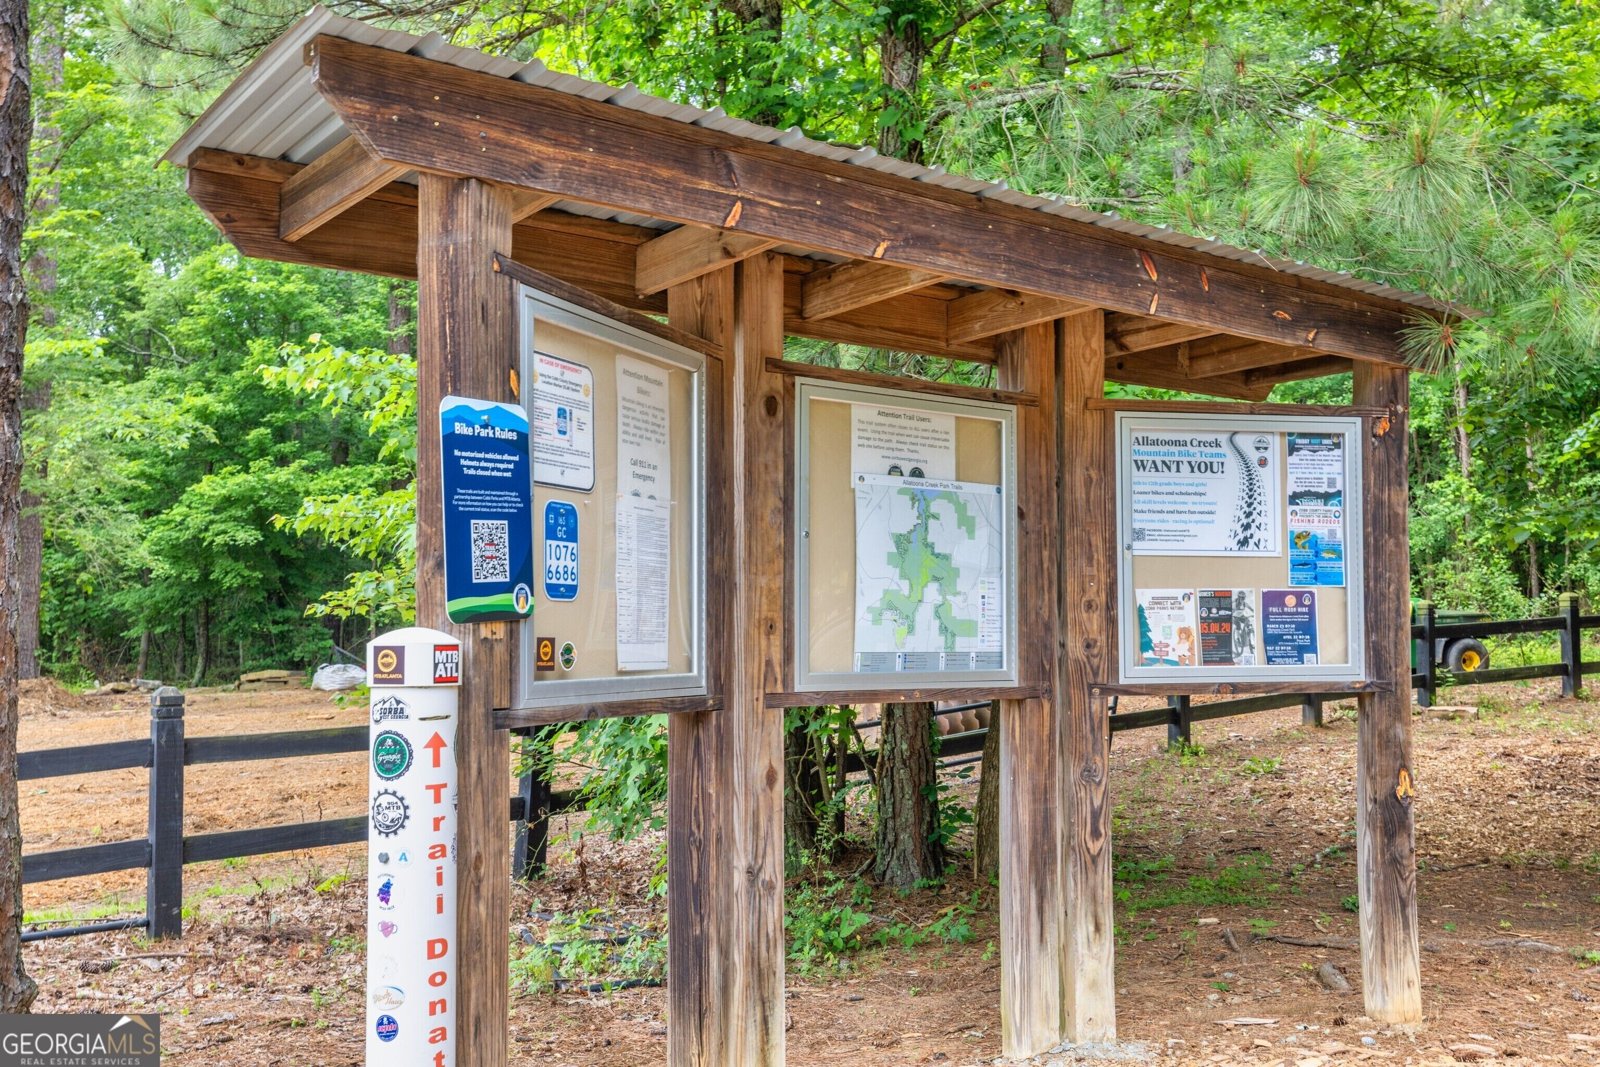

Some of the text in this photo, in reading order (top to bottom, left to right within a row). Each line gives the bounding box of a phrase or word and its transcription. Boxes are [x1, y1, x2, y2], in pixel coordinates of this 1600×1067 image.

[877, 410, 902, 420] Attention
[454, 422, 473, 436] Bike
[474, 424, 494, 438] Park
[494, 426, 518, 440] Rules
[1132, 436, 1222, 448] Allatoona Creek
[462, 450, 484, 458] motorized
[484, 452, 502, 460] vehicles
[1132, 448, 1227, 459] Mountain Bike Teams
[460, 458, 514, 470] Helmets always required
[630, 458, 638, 466] Call
[647, 462, 652, 470] in
[1133, 459, 1225, 474] WANT YOU!
[476, 468, 490, 476] closed
[632, 470, 656, 484] Emergency
[902, 479, 924, 488] Allatoona
[924, 480, 939, 488] Creek
[556, 526, 566, 538] GC
[548, 544, 576, 562] 1076
[547, 564, 576, 582] 6686
[435, 650, 458, 664] MTB
[436, 662, 458, 678] ATL
[380, 706, 404, 715] SORBA
